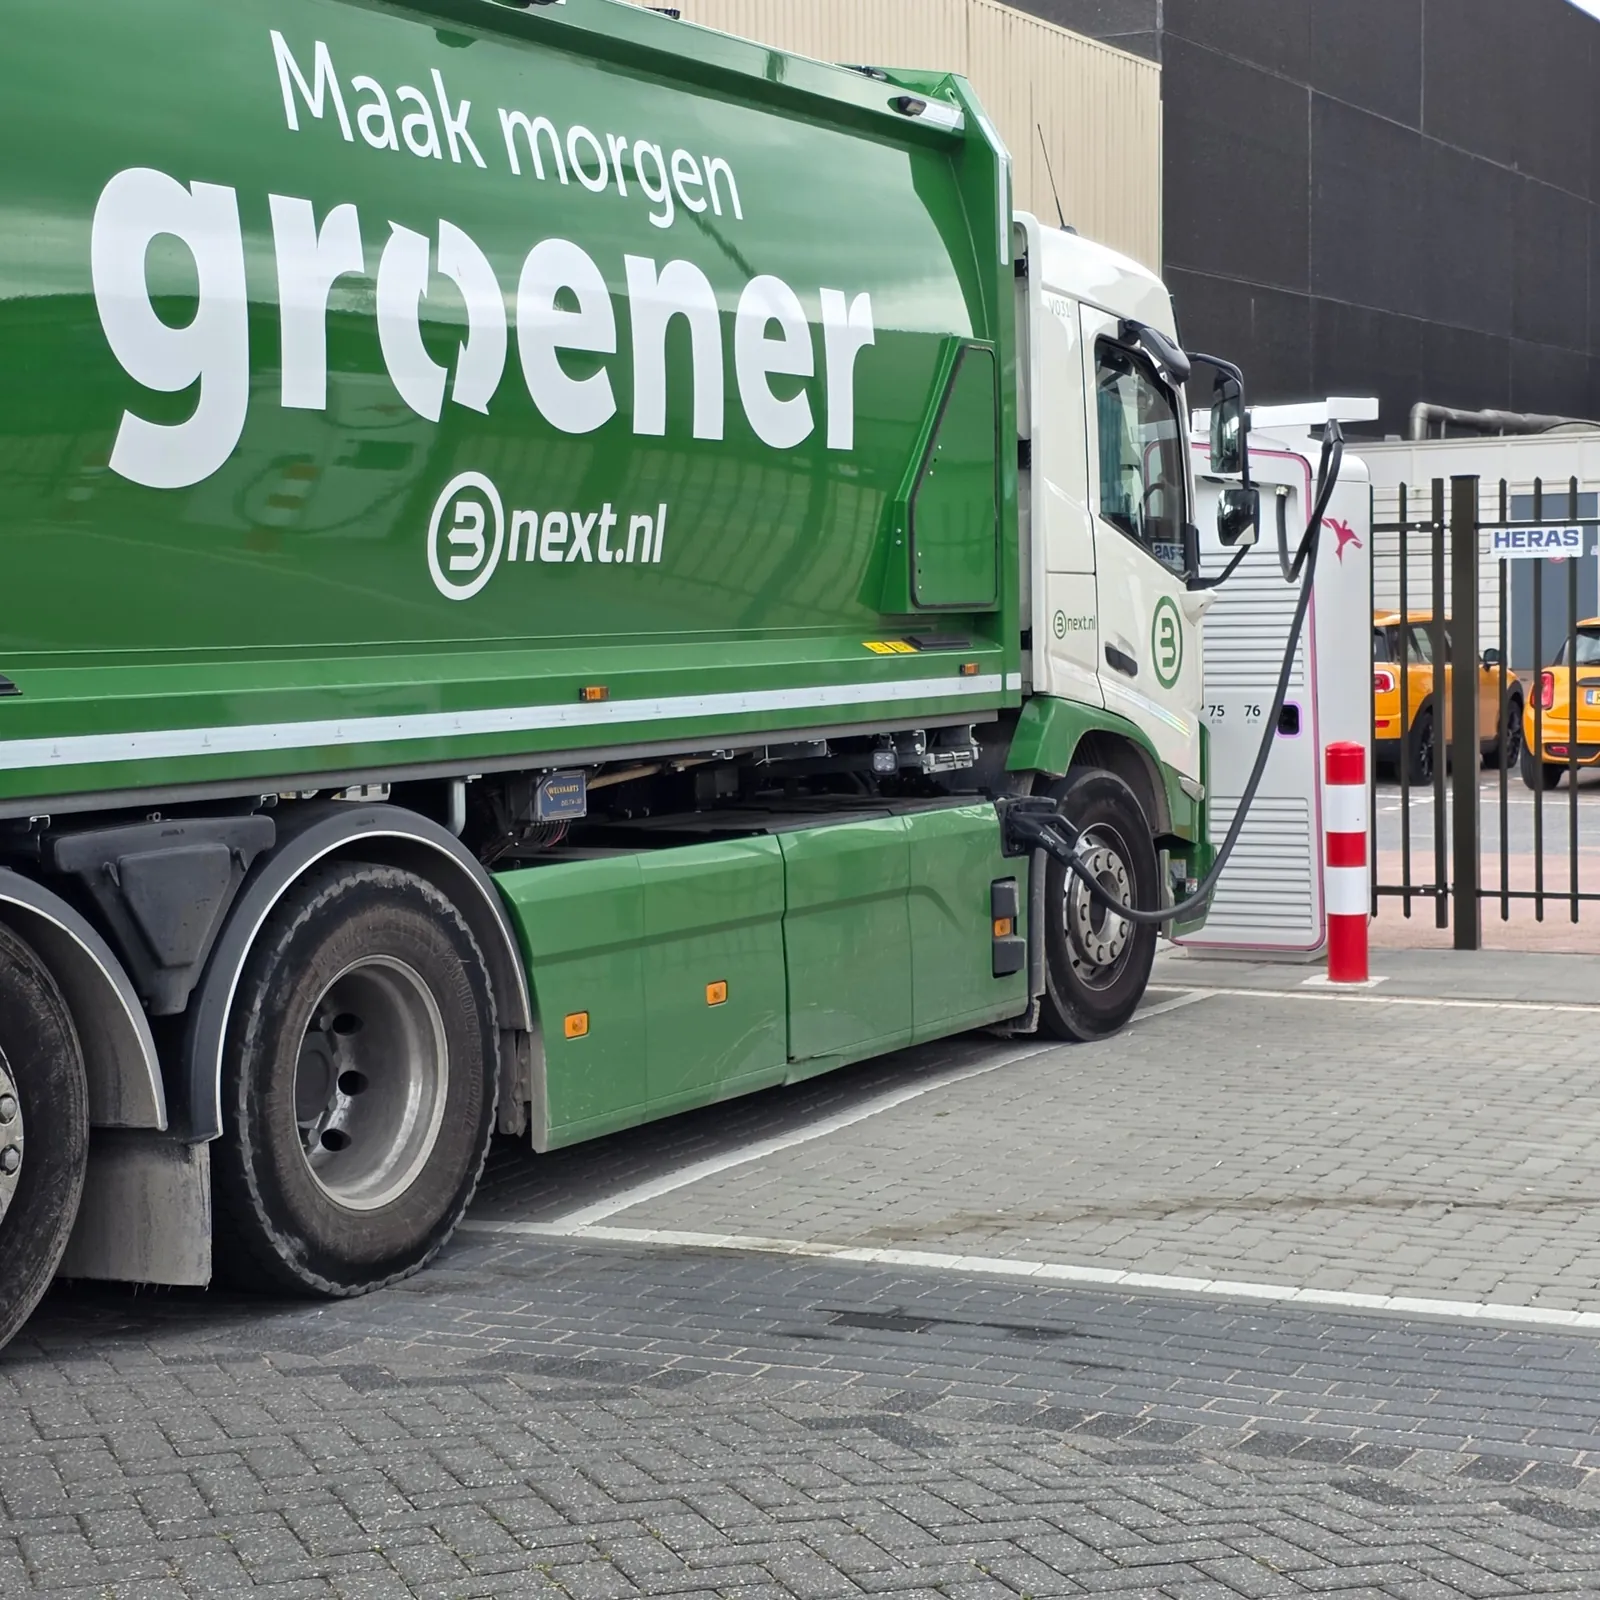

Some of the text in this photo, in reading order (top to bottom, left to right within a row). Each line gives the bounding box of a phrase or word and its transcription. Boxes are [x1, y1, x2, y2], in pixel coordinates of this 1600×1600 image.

[269, 29, 744, 230] Maak morgen
[91, 166, 877, 490] groener
[1494, 529, 1579, 549] HERAS
[1208, 704, 1225, 717] 75
[1244, 704, 1261, 717] 76
